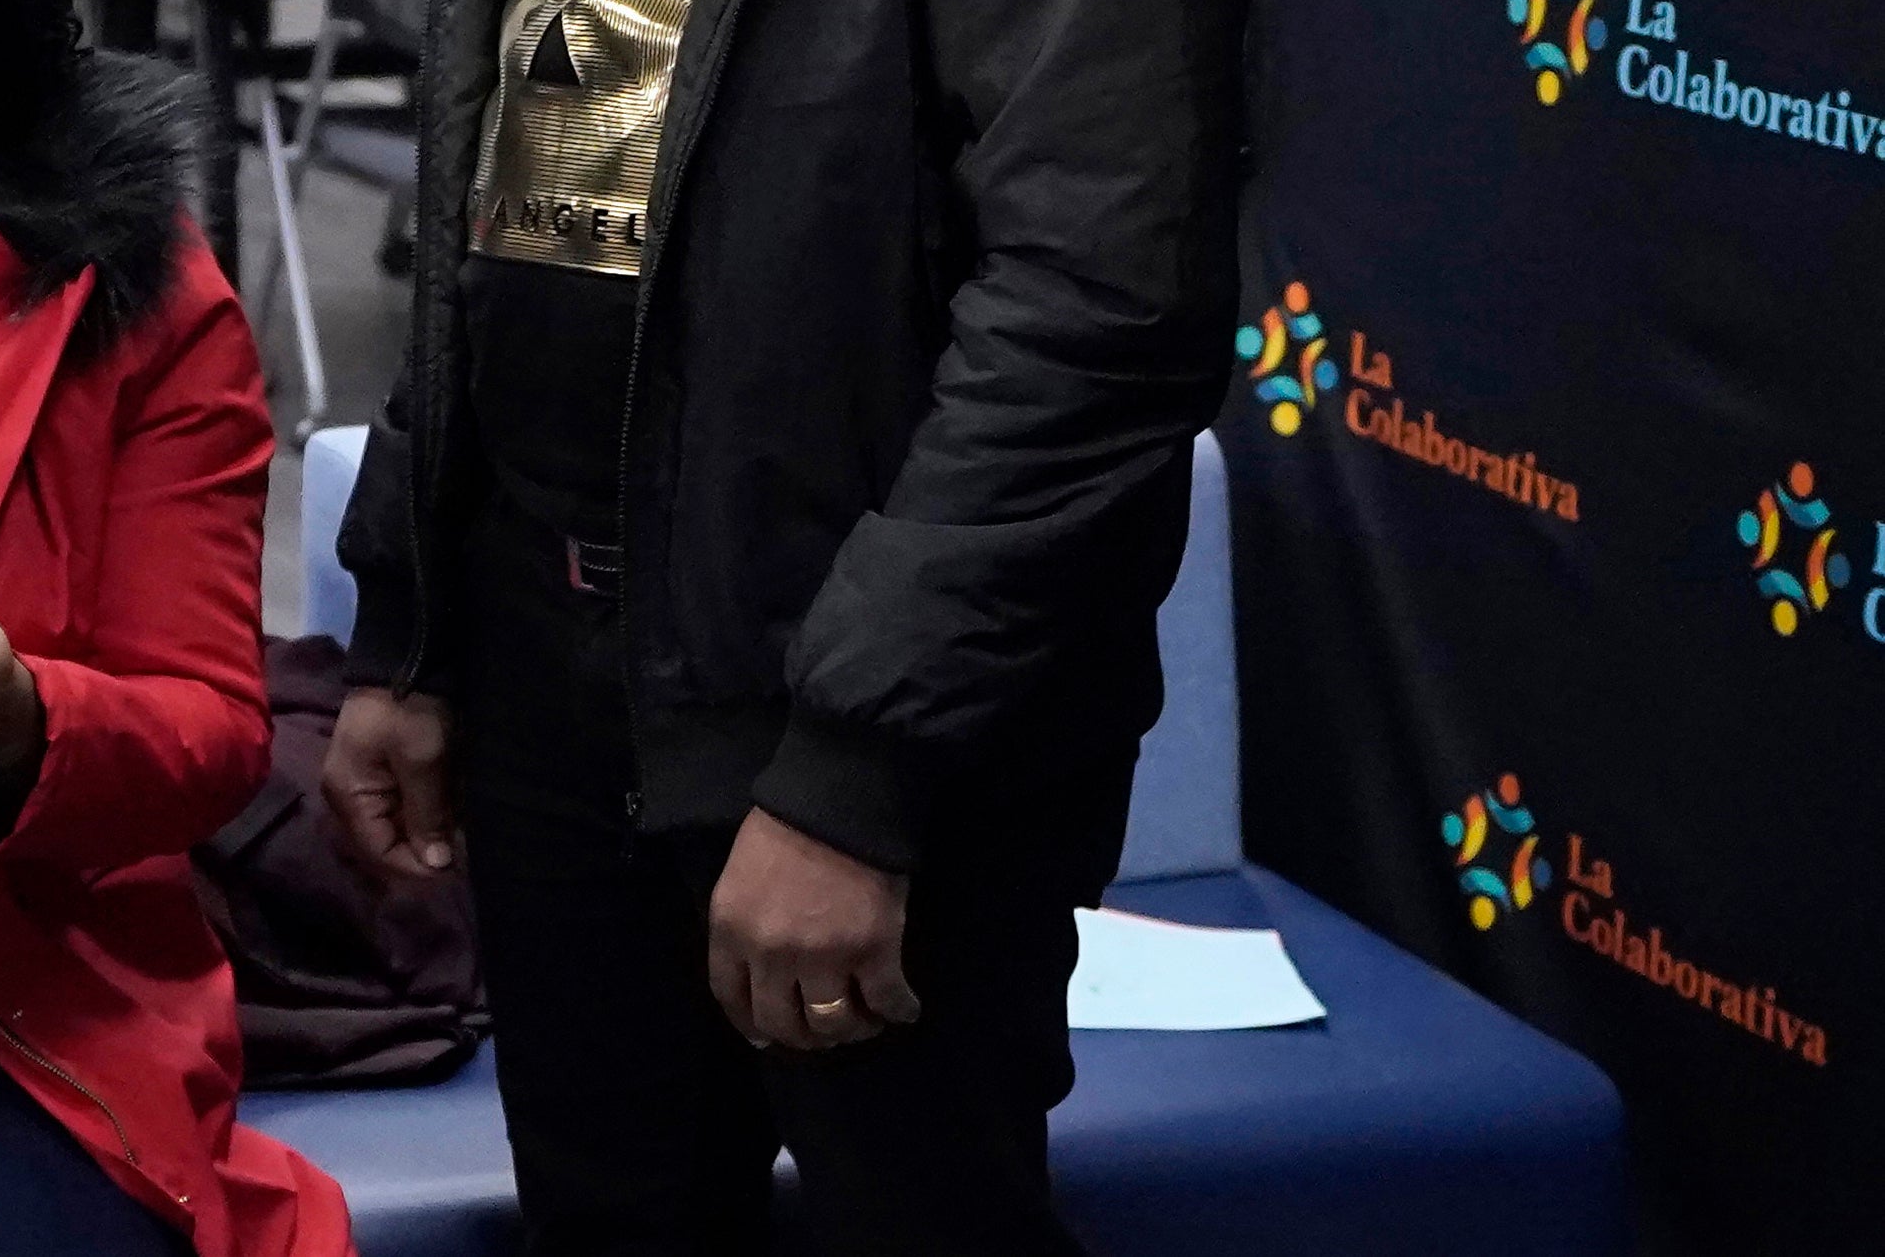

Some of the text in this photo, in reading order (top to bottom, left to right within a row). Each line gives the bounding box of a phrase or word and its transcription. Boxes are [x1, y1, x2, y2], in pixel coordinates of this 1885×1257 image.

[1350, 331, 1393, 389] La
[1344, 388, 1579, 522] Colaborativa
[1566, 833, 1614, 899] La
[1561, 890, 1827, 1067] Colaborativa
